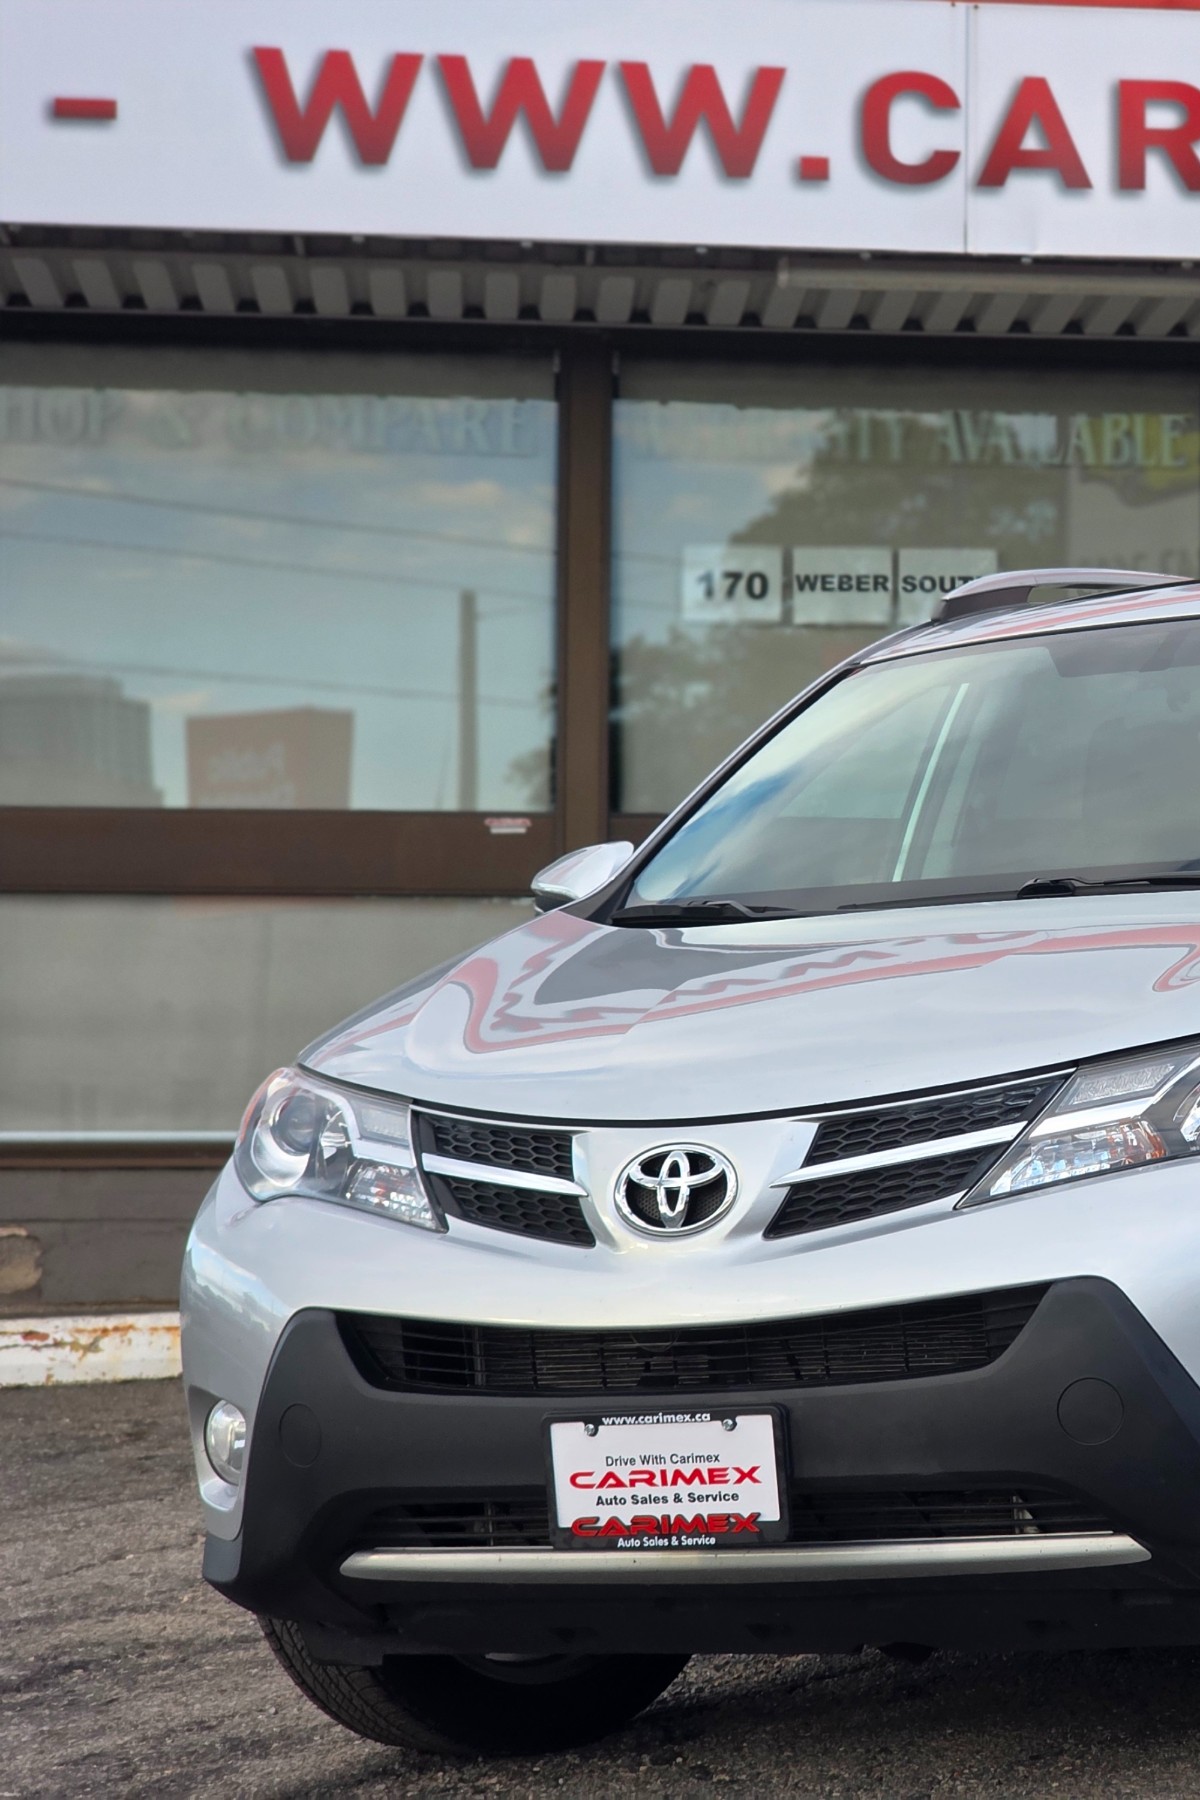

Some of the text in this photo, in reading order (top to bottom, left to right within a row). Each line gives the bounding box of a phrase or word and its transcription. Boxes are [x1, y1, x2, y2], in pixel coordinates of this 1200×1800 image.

[696, 571, 982, 601] 170 WEBER SOU
[602, 1412, 711, 1425] www.carimex.ca
[605, 1453, 720, 1467] Drive With Carimex
[569, 1465, 762, 1489] CARIMEX
[596, 1490, 739, 1507] Auto Sales & Service
[571, 1512, 761, 1537] CARIMEX
[617, 1534, 716, 1548] Auto Sales & Service
